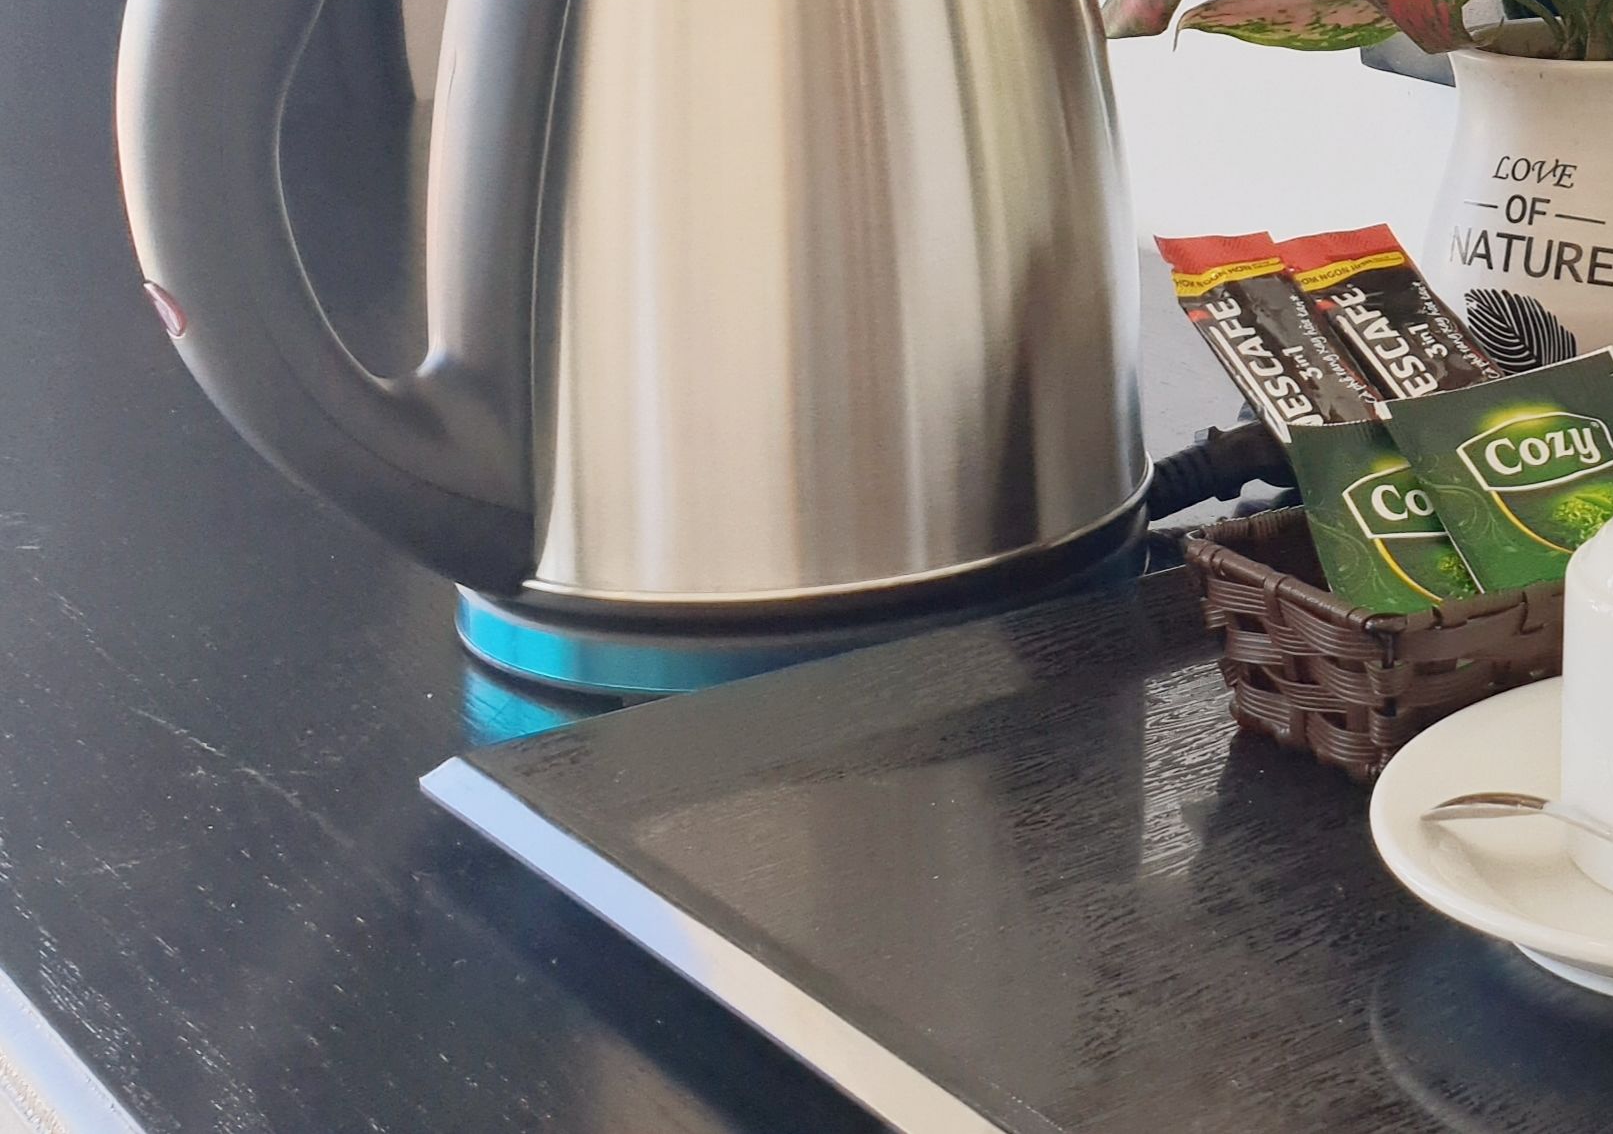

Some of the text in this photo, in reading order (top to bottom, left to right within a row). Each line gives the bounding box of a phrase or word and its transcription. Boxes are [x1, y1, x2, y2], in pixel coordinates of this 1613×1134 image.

[1492, 156, 1577, 189] LOVE
[1505, 194, 1551, 225] OF
[1485, 427, 1601, 475] Cozy
[1371, 484, 1434, 522] Co
